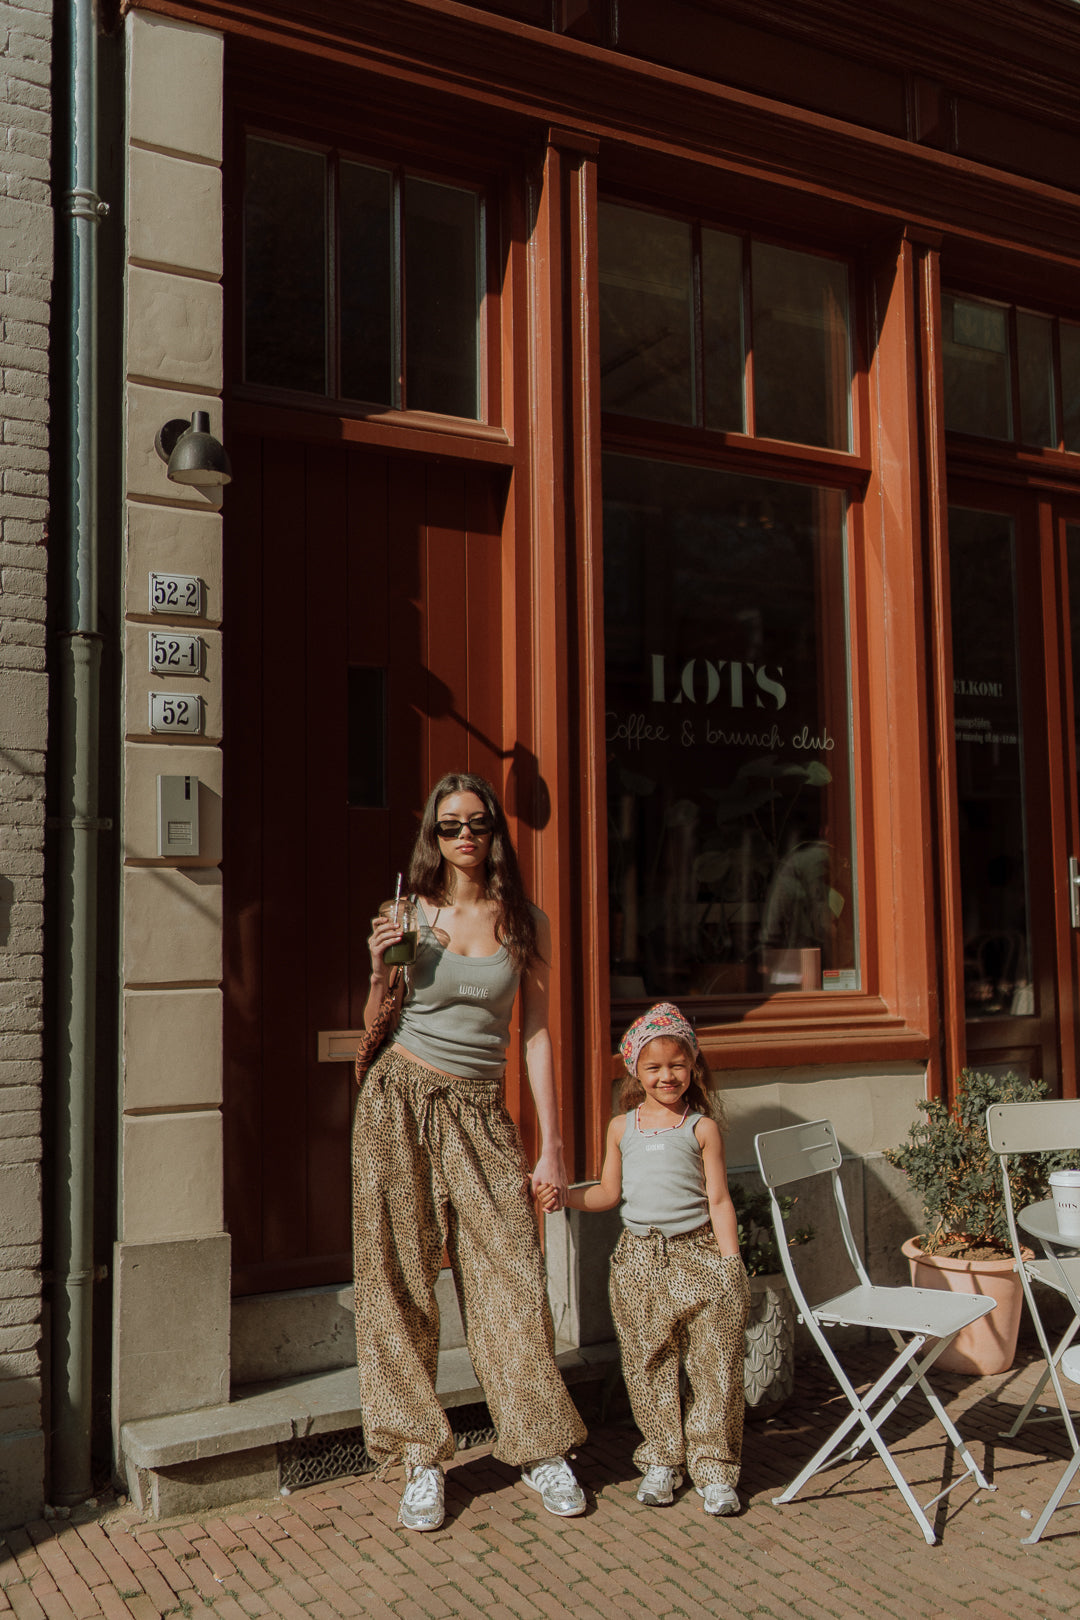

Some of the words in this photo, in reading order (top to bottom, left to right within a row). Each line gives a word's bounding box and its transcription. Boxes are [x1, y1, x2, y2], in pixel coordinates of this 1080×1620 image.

[154, 580, 197, 607] 52-2
[154, 639, 197, 667] 52-1
[651, 653, 787, 711] LOTS
[953, 680, 1003, 697] ELKOM!
[162, 700, 189, 725] 52
[681, 719, 696, 747] &
[706, 719, 785, 749] brunch
[792, 725, 835, 750] club
